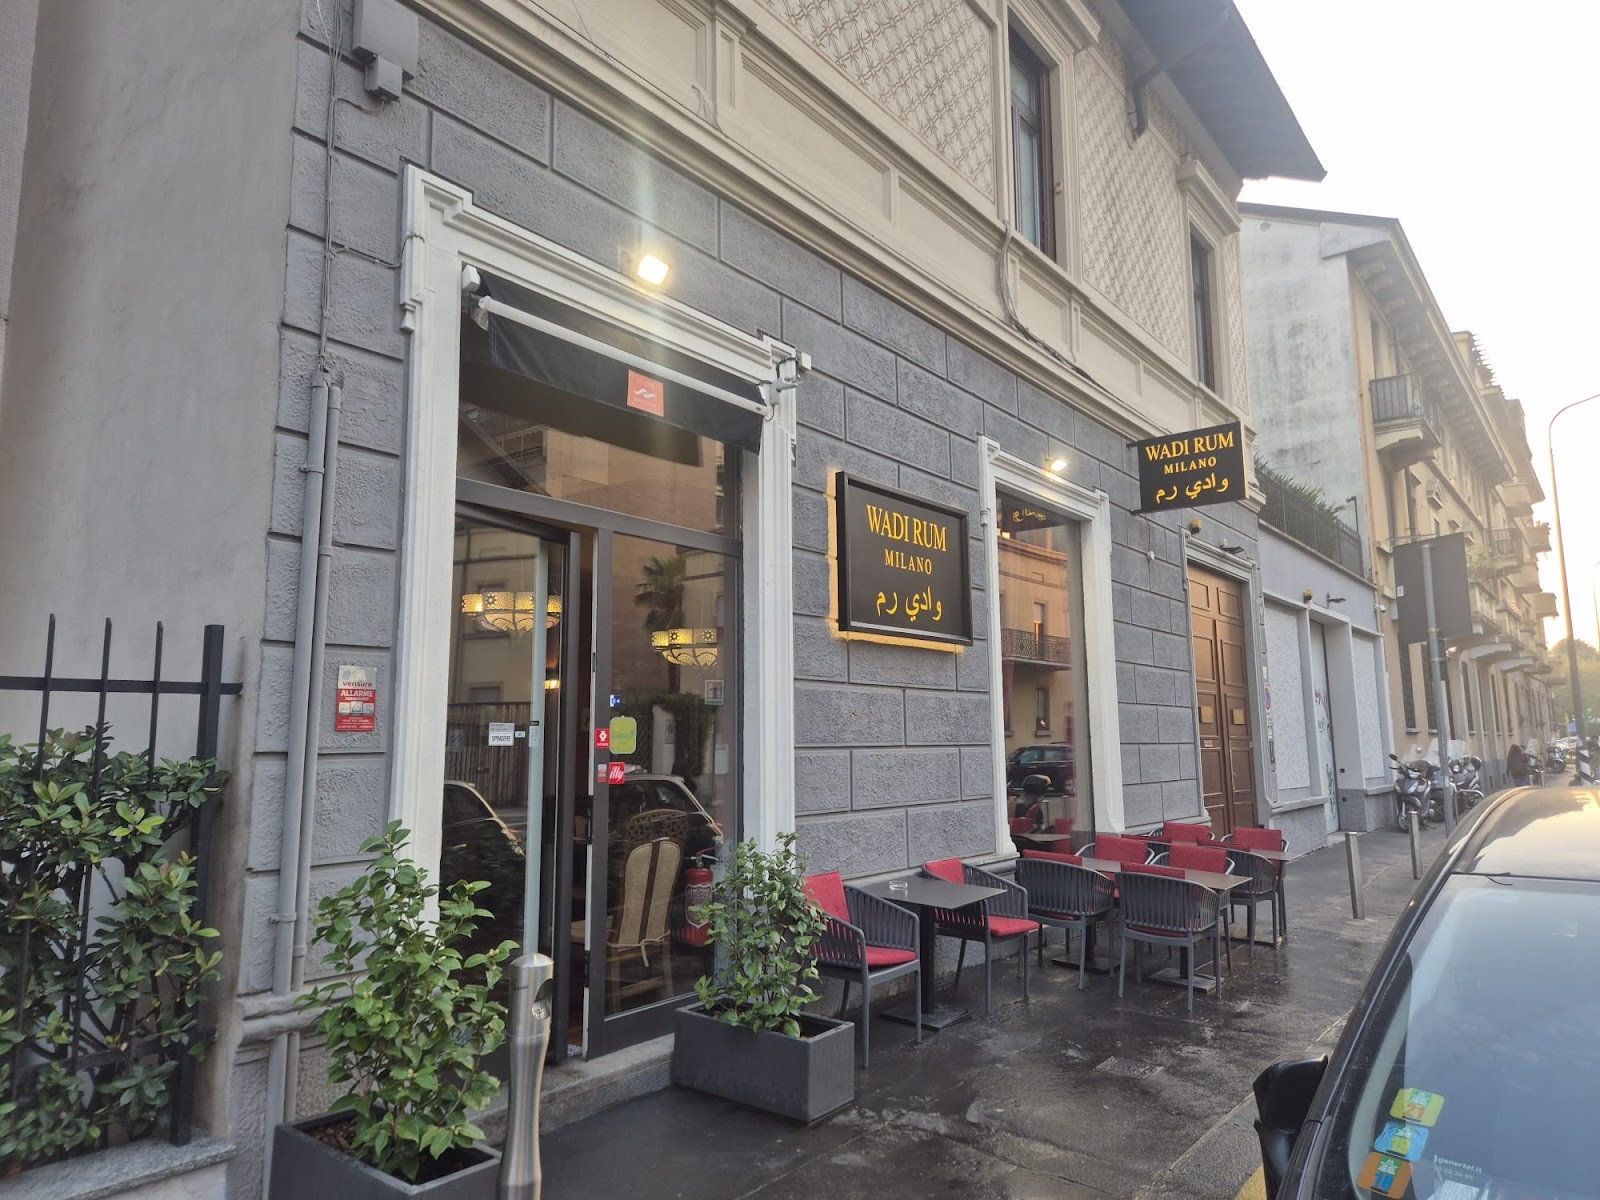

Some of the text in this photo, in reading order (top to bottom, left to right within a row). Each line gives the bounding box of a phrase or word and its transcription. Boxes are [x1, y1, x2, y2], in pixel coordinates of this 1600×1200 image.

[1145, 431, 1235, 461] WADI RUM
[1164, 456, 1217, 475] MILANO
[1156, 472, 1229, 504] وادي رم
[866, 504, 948, 552] WADI RUM
[884, 548, 932, 575] MILANO
[876, 586, 943, 623] وادي رم
[341, 689, 373, 697] ALLARME
[609, 765, 624, 782] illy
[1405, 1103, 1426, 1120] 21
